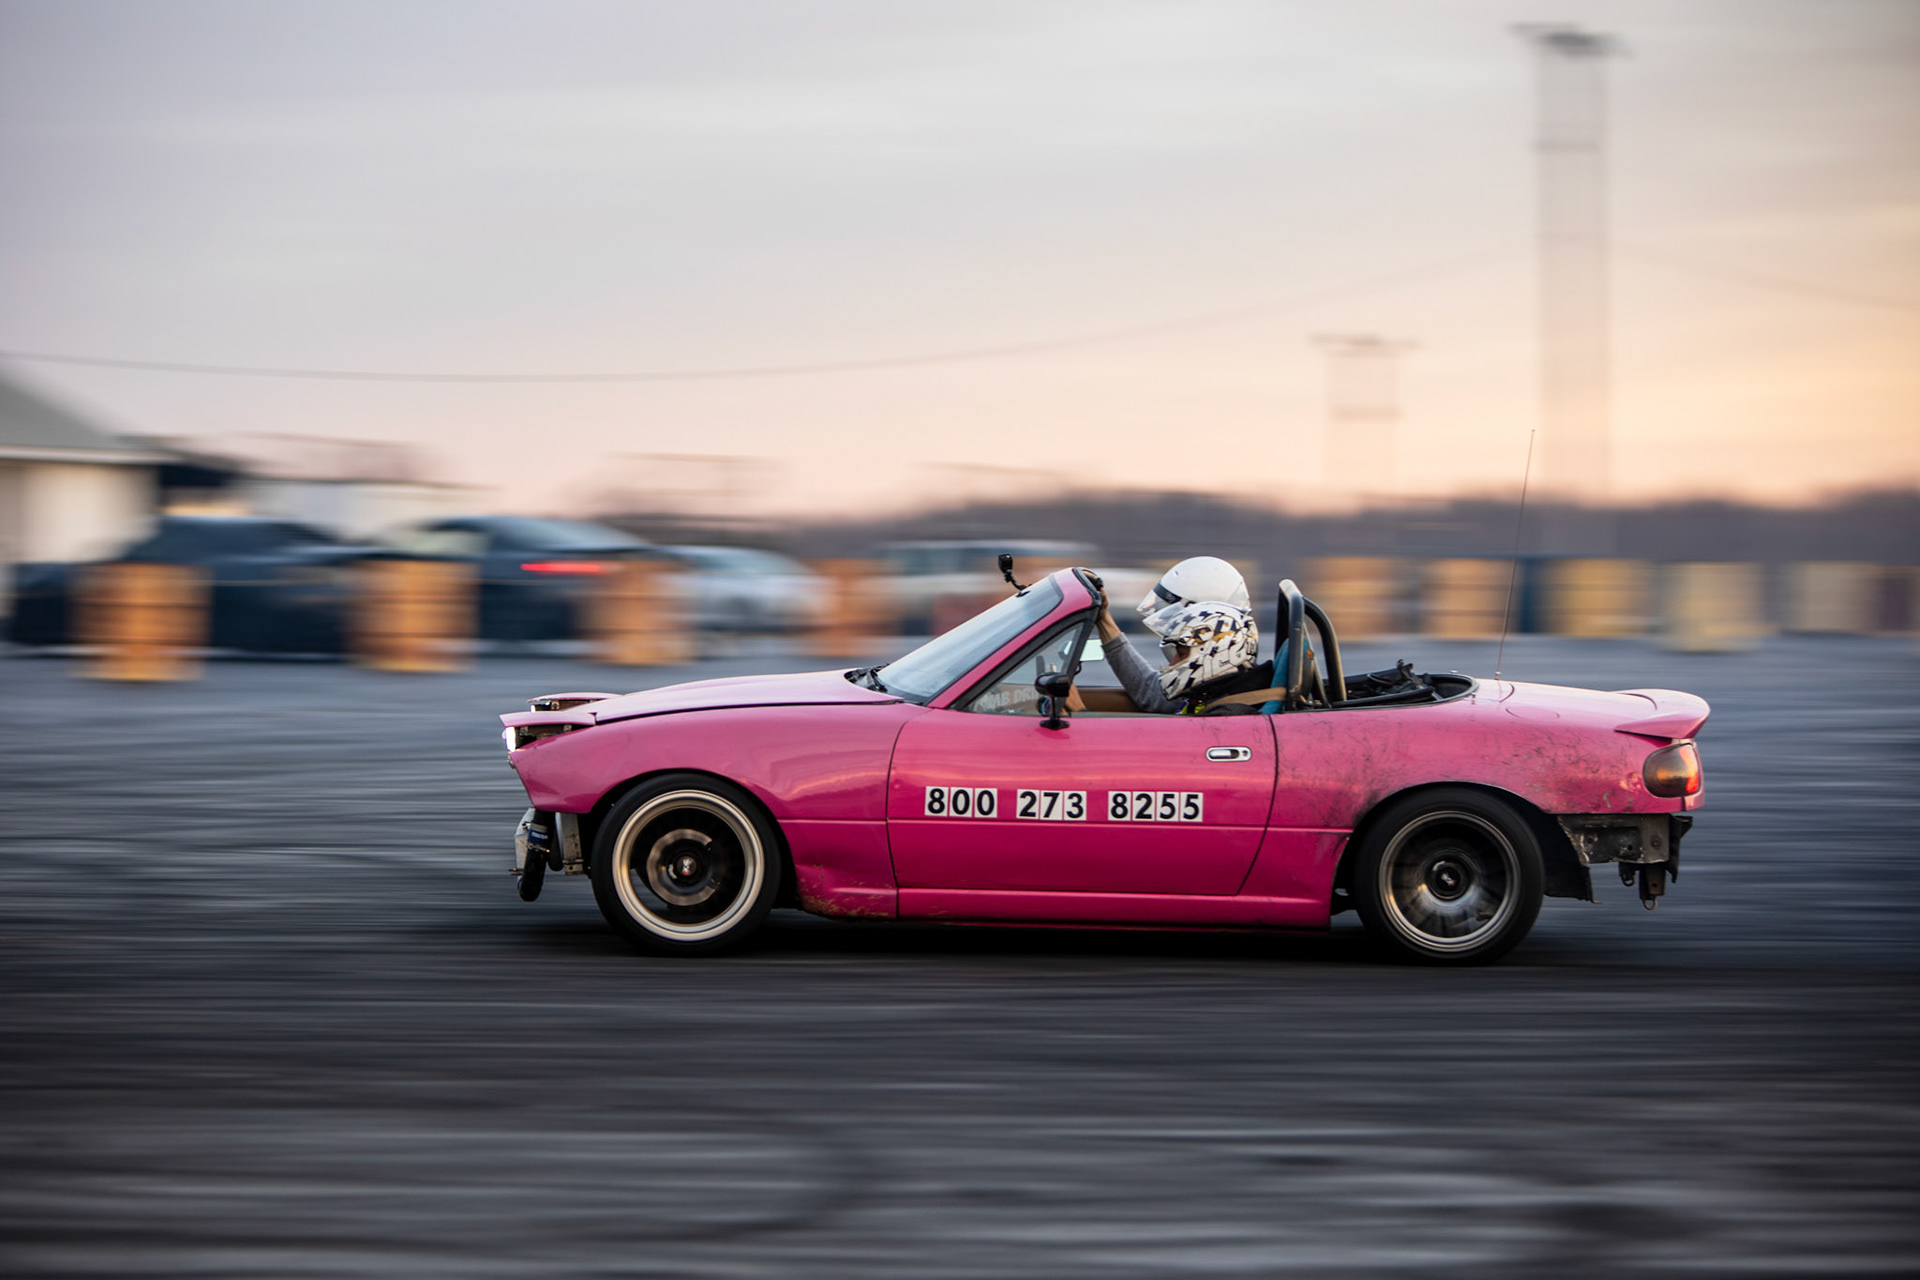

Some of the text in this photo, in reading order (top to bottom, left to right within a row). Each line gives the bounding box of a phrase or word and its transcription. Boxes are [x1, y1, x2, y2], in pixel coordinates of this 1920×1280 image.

[927, 788, 1200, 820] 800 273 8255
